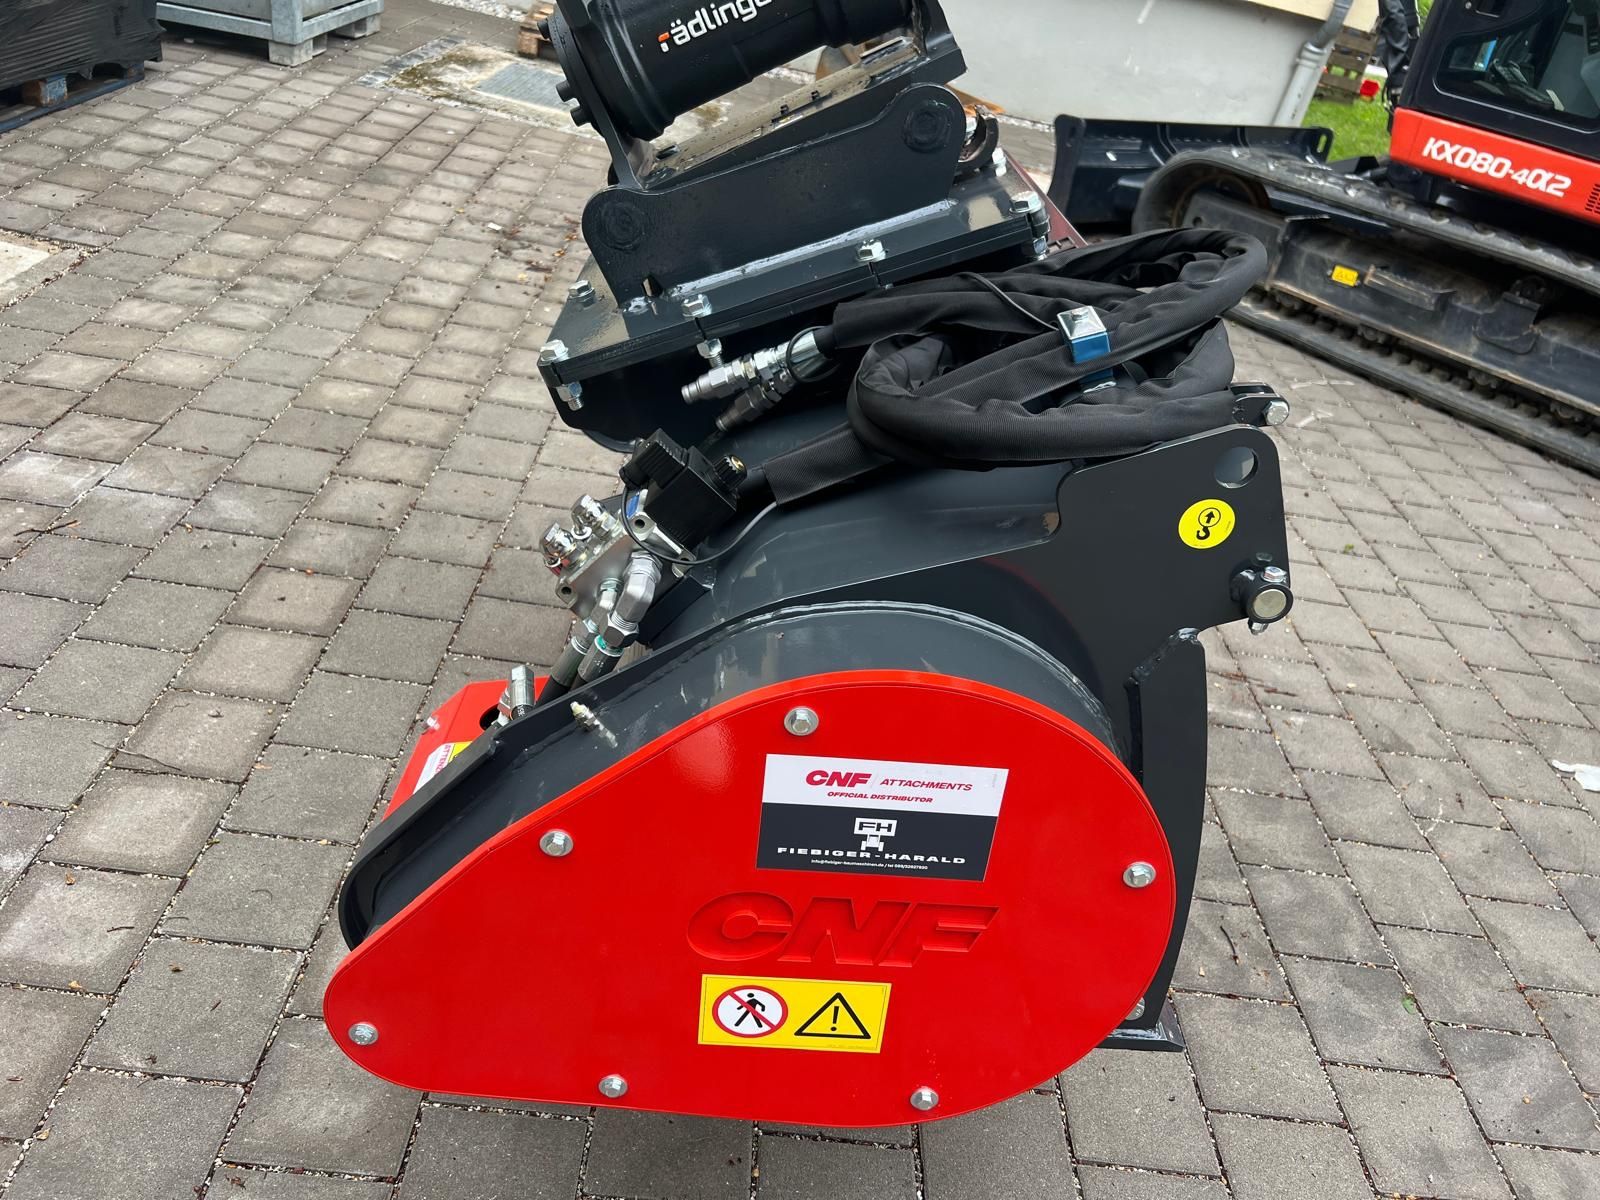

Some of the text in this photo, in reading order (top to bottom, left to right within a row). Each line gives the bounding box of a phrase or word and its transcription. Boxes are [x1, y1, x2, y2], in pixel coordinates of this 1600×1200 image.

[805, 769, 872, 788] CNF
[879, 778, 973, 791] ATTACHMENTS
[827, 791, 933, 803] OFFICIAL DISTRIBUTOR
[857, 822, 893, 834] FH
[686, 890, 1000, 968] CNF
